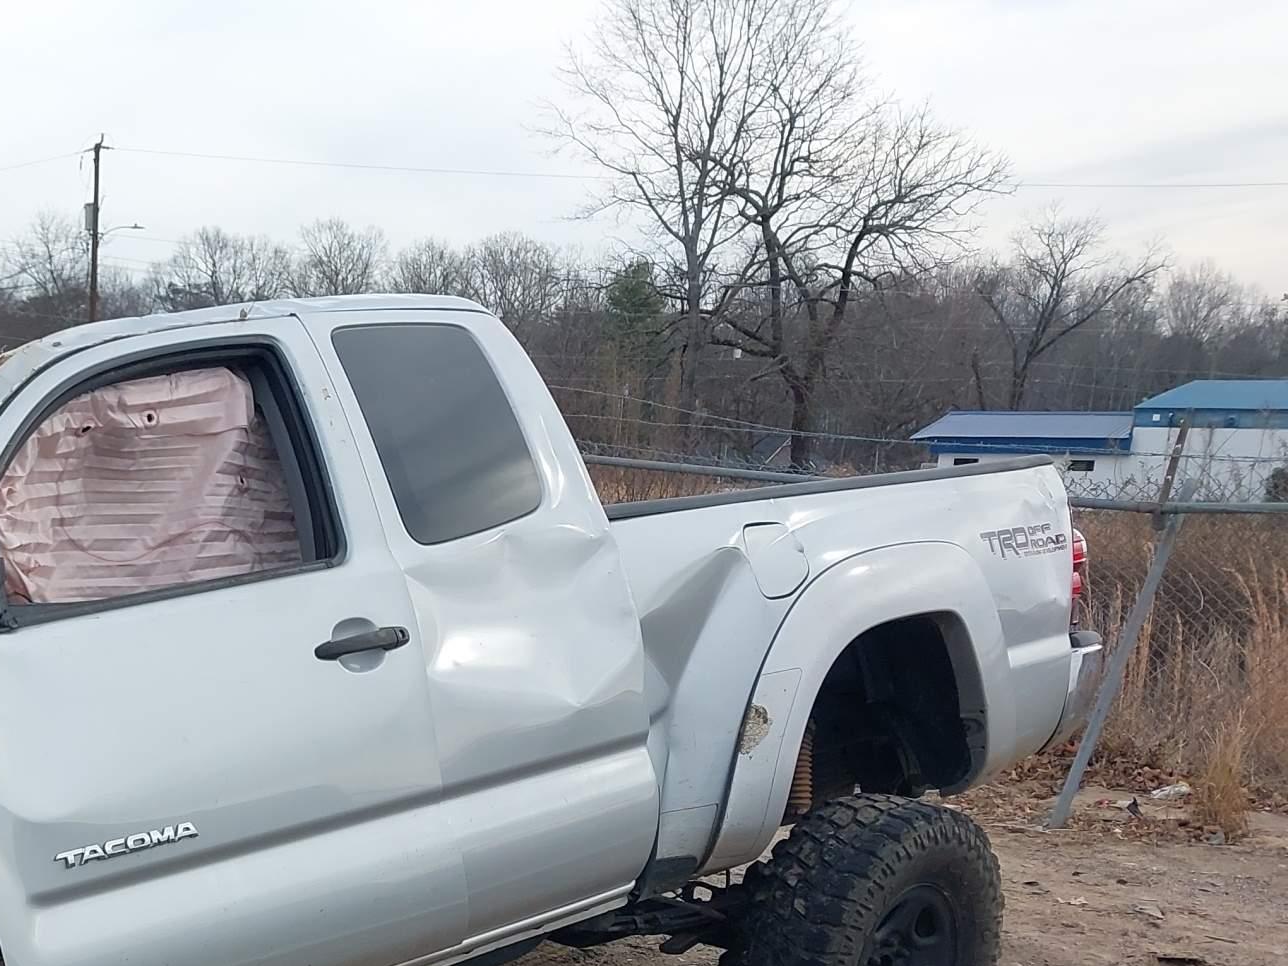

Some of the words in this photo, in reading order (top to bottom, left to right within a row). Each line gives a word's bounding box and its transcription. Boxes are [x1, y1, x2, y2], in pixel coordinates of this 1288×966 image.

[1027, 523, 1052, 537] OFF
[1030, 533, 1067, 549] ROAD
[979, 526, 1029, 559] TRD
[54, 821, 200, 868] TACOMA
